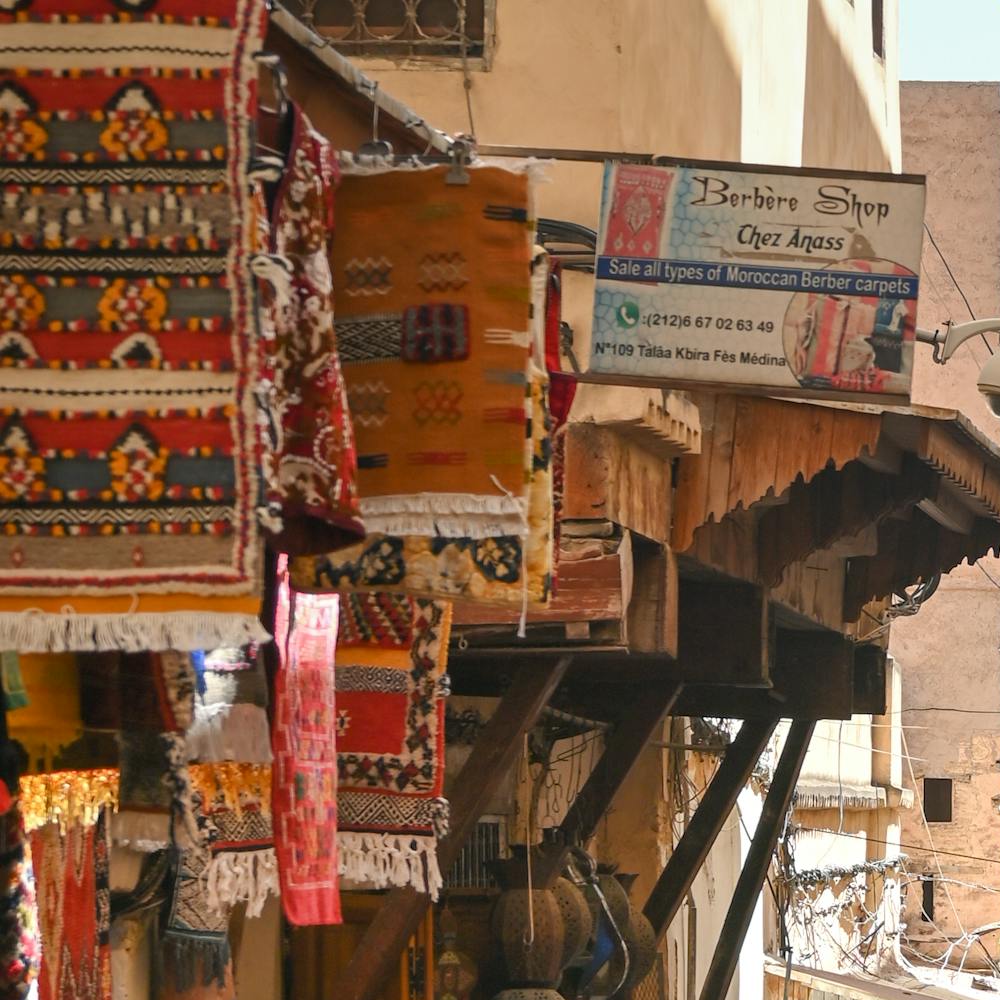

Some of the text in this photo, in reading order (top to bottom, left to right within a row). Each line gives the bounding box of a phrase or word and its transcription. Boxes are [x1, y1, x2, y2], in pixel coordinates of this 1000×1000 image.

[690, 176, 890, 229] Berbère Shop
[737, 223, 845, 254] Chez Anass
[608, 258, 911, 297] Sale all types of Moroccan Berber carpets
[694, 316, 712, 329] 67
[715, 317, 733, 331] 02
[735, 318, 753, 332] 63
[756, 320, 774, 334] 49
[675, 346, 710, 362] Kbira
[713, 349, 737, 364] Fès
[739, 352, 787, 368] Médina
